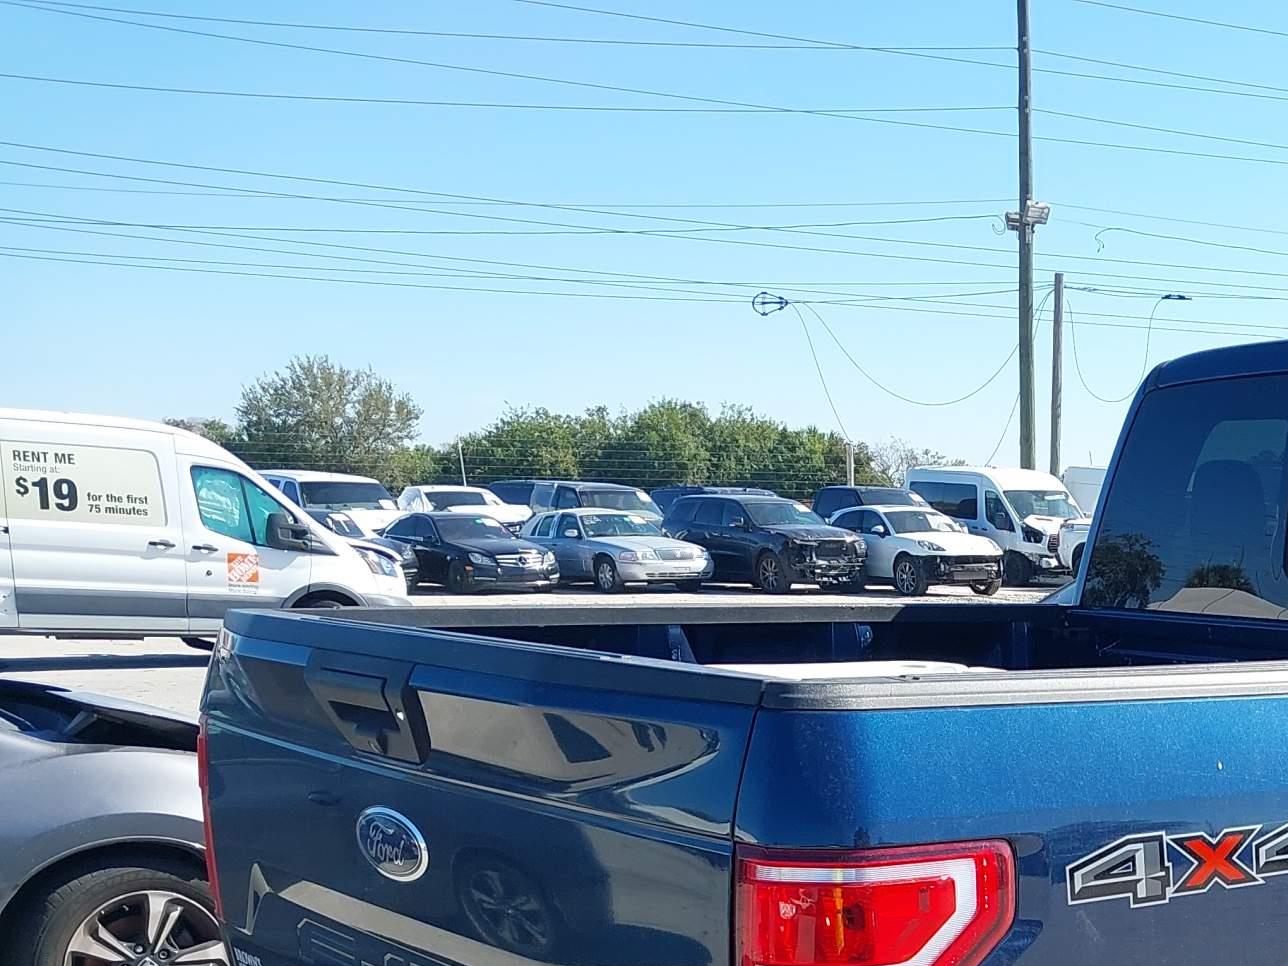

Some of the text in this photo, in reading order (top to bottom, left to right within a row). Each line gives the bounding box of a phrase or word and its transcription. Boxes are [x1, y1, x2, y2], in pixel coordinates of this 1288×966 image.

[12, 450, 76, 465] RENT ME
[13, 463, 47, 475] Starting
[15, 475, 79, 512] $19
[87, 492, 148, 505] for the first
[88, 504, 148, 516] 75 minutes
[367, 821, 405, 866] Ford
